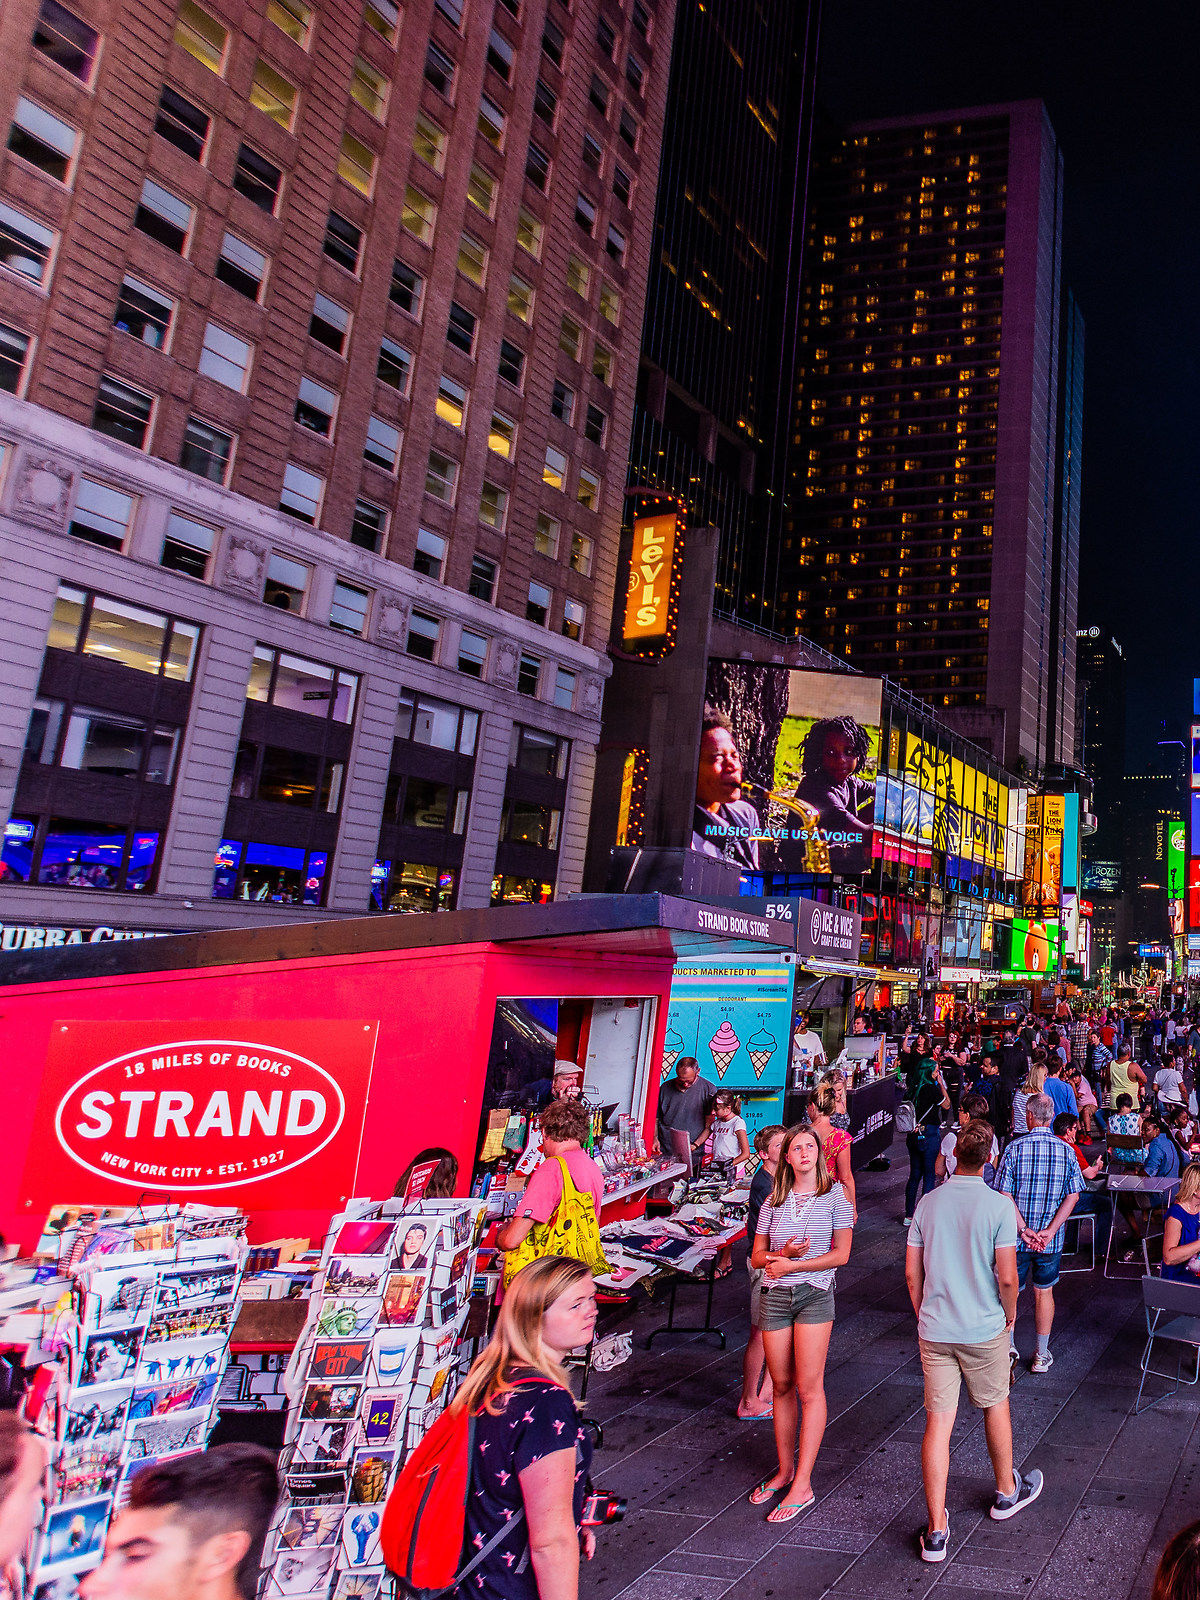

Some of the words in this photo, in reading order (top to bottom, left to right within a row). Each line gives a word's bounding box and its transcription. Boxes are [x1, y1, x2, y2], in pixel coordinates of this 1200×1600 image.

[636, 526, 665, 627] Levi's
[1046, 816, 1062, 825] LION
[705, 825, 749, 837] MUSIC
[752, 827, 789, 840] GAVE
[792, 829, 808, 840] US
[811, 831, 820, 841] A
[823, 831, 863, 843] VOICE
[1156, 820, 1164, 860] NOVOTEL
[1091, 866, 1121, 876] FROZEN
[765, 903, 793, 920] 5%
[698, 910, 729, 932] STRAND
[730, 916, 749, 935] BOOK
[750, 920, 770, 938] STORE
[822, 911, 833, 932] ICE
[834, 915, 839, 935] &
[840, 917, 853, 937] VICE
[0, 922, 83, 951] UBBA
[820, 935, 833, 947] CRAFT
[840, 938, 852, 949] CREAM
[700, 968, 744, 976] MARKETED
[746, 968, 757, 976] TO
[124, 1063, 146, 1078] 18
[152, 1053, 203, 1070] MILES
[209, 1053, 232, 1065] OF
[237, 1054, 292, 1077] BOOKS
[75, 1090, 327, 1139] STRAND
[100, 1151, 129, 1169] NEW
[133, 1162, 167, 1177] YORK
[171, 1166, 202, 1177] CITY
[218, 1162, 248, 1176] EST.
[252, 1149, 285, 1169] 1927
[315, 1345, 339, 1363] NEW
[326, 1357, 349, 1375] CITY
[370, 1411, 389, 1426] 42
